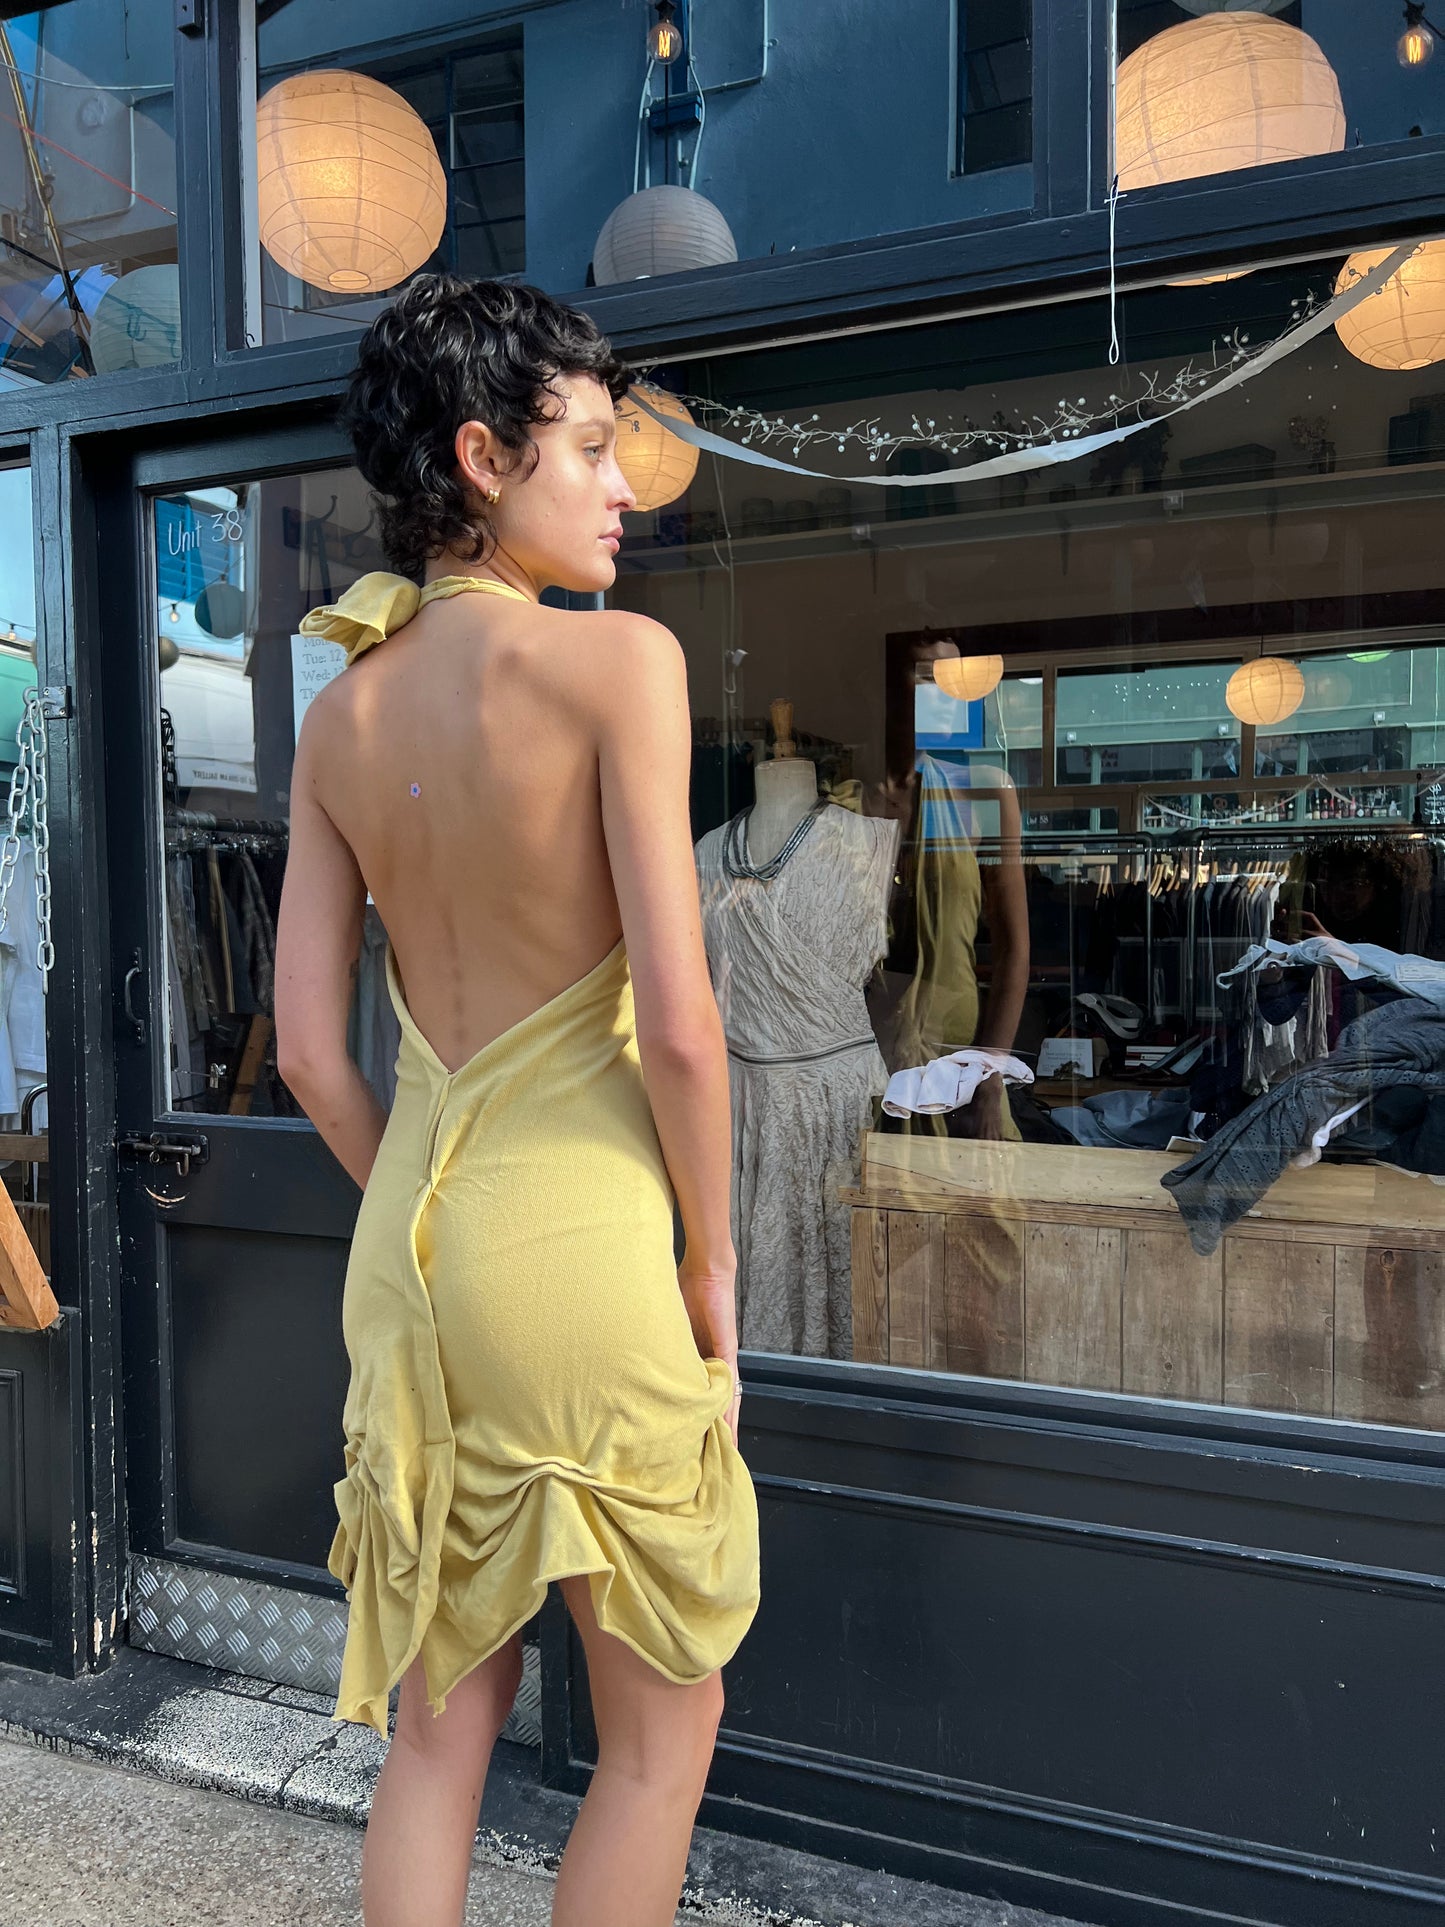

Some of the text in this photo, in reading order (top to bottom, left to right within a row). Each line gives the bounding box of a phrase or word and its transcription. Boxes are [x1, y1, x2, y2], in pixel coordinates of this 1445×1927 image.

[168, 509, 243, 555] Unit 38
[302, 653, 327, 665] Tue:
[301, 668, 331, 681] Wed:
